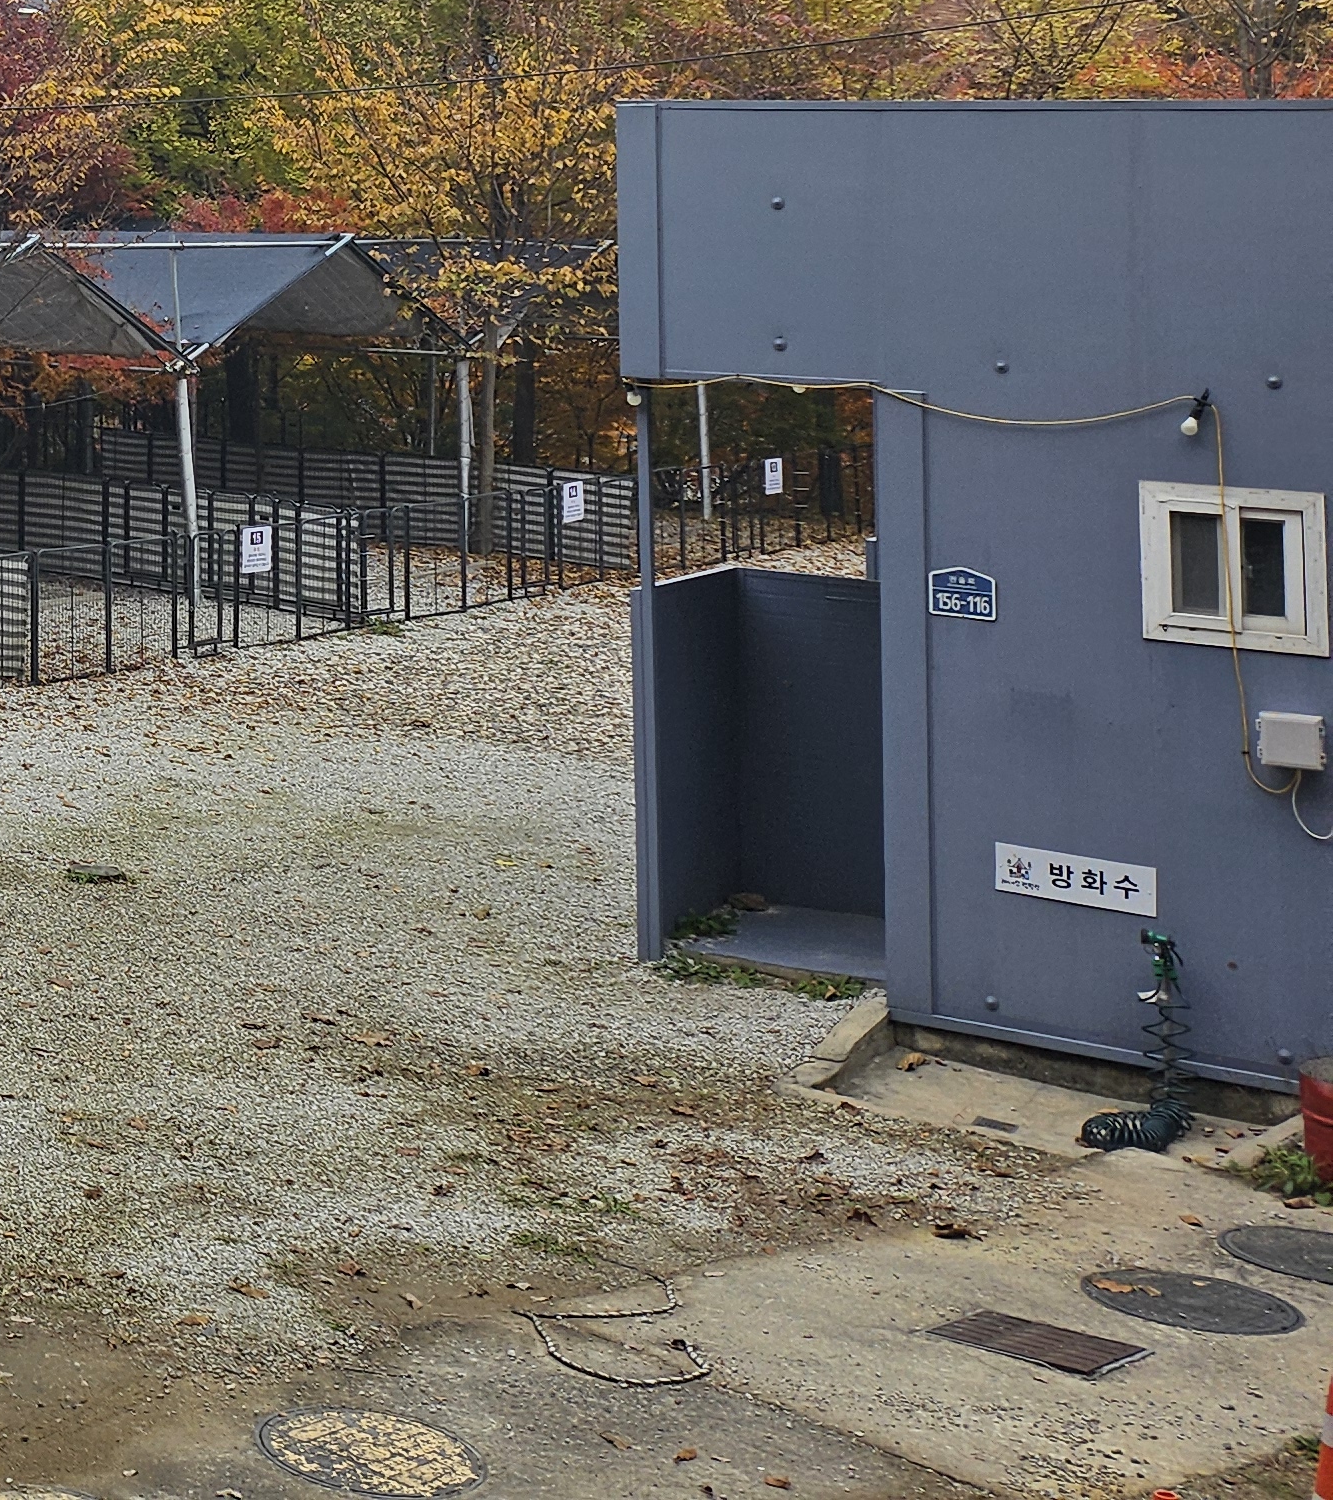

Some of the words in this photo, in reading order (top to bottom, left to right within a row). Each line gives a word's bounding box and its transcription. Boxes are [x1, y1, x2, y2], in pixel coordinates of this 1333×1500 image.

[253, 532, 262, 544] 15
[935, 592, 991, 615] 156-116
[1048, 862, 1141, 900] 방화수
